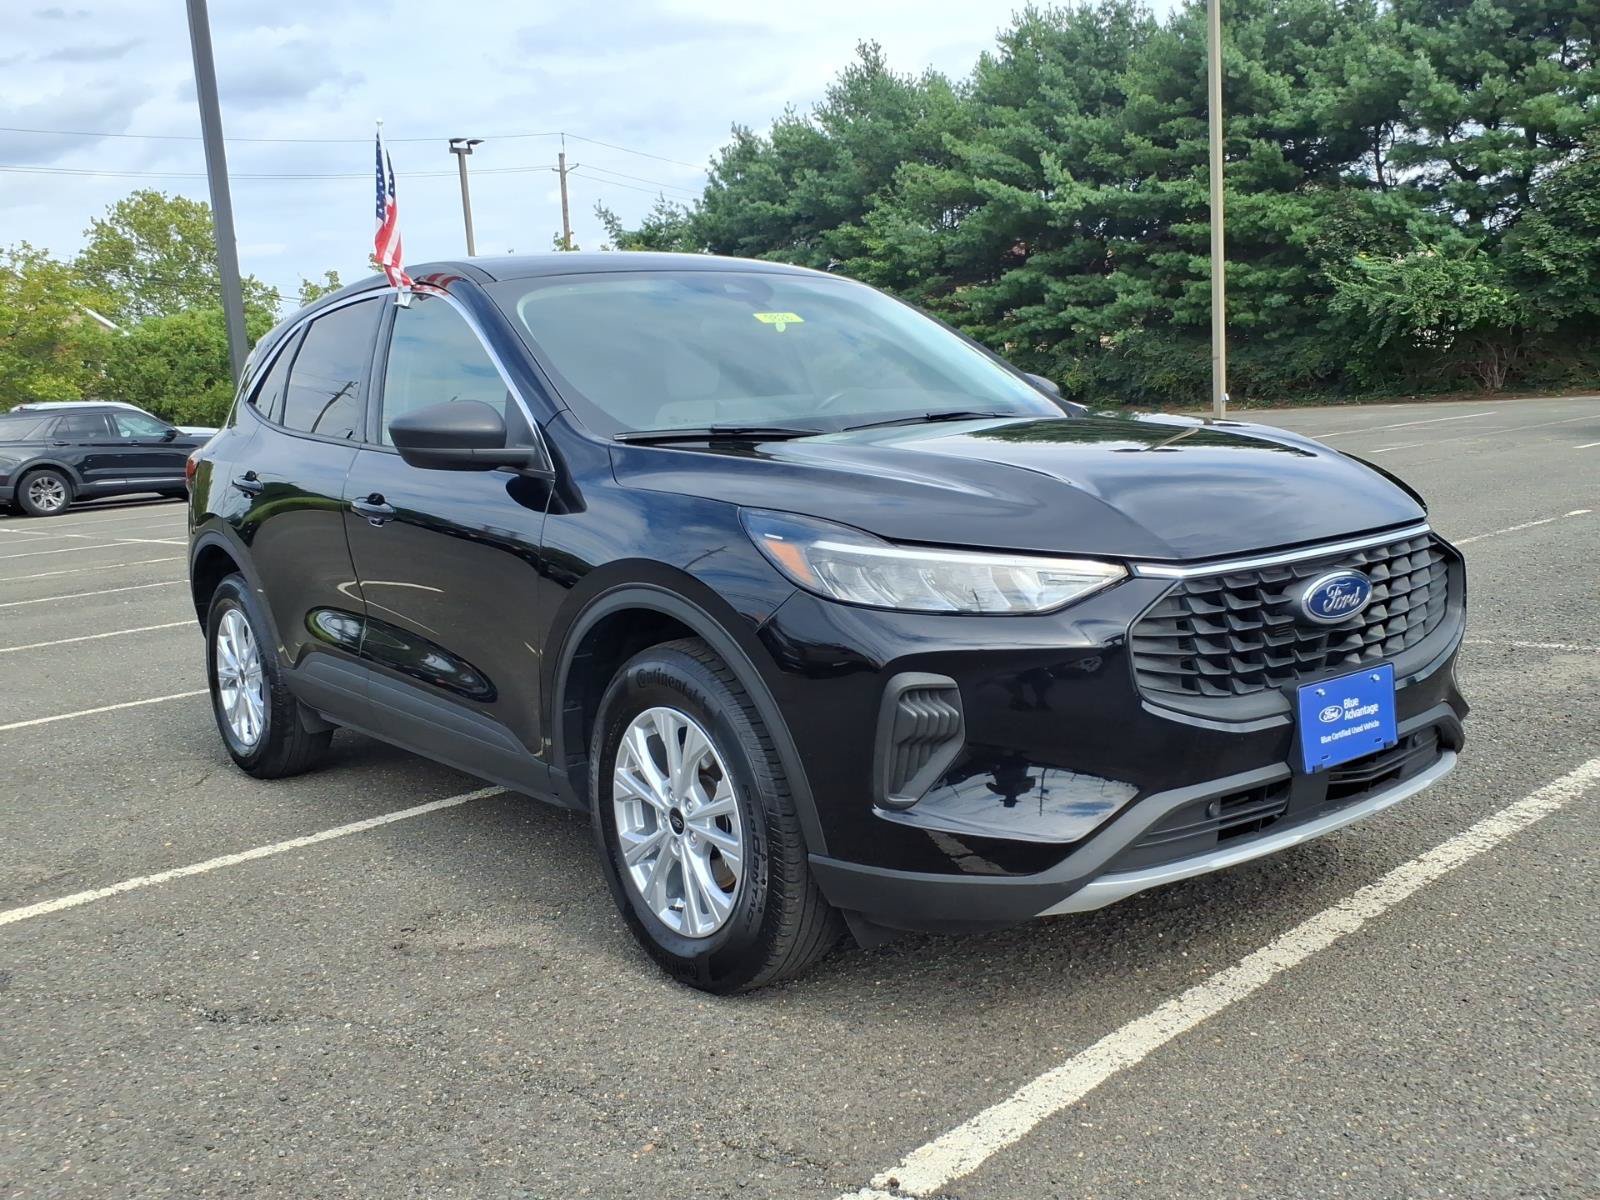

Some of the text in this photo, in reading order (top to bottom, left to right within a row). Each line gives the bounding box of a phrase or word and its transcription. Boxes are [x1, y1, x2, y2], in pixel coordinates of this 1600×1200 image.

[1323, 583, 1361, 612] Ford
[1343, 697, 1359, 709] Blue
[1344, 703, 1379, 720] Advantage
[1320, 720, 1380, 744] Blue Certified Used Vehicle
